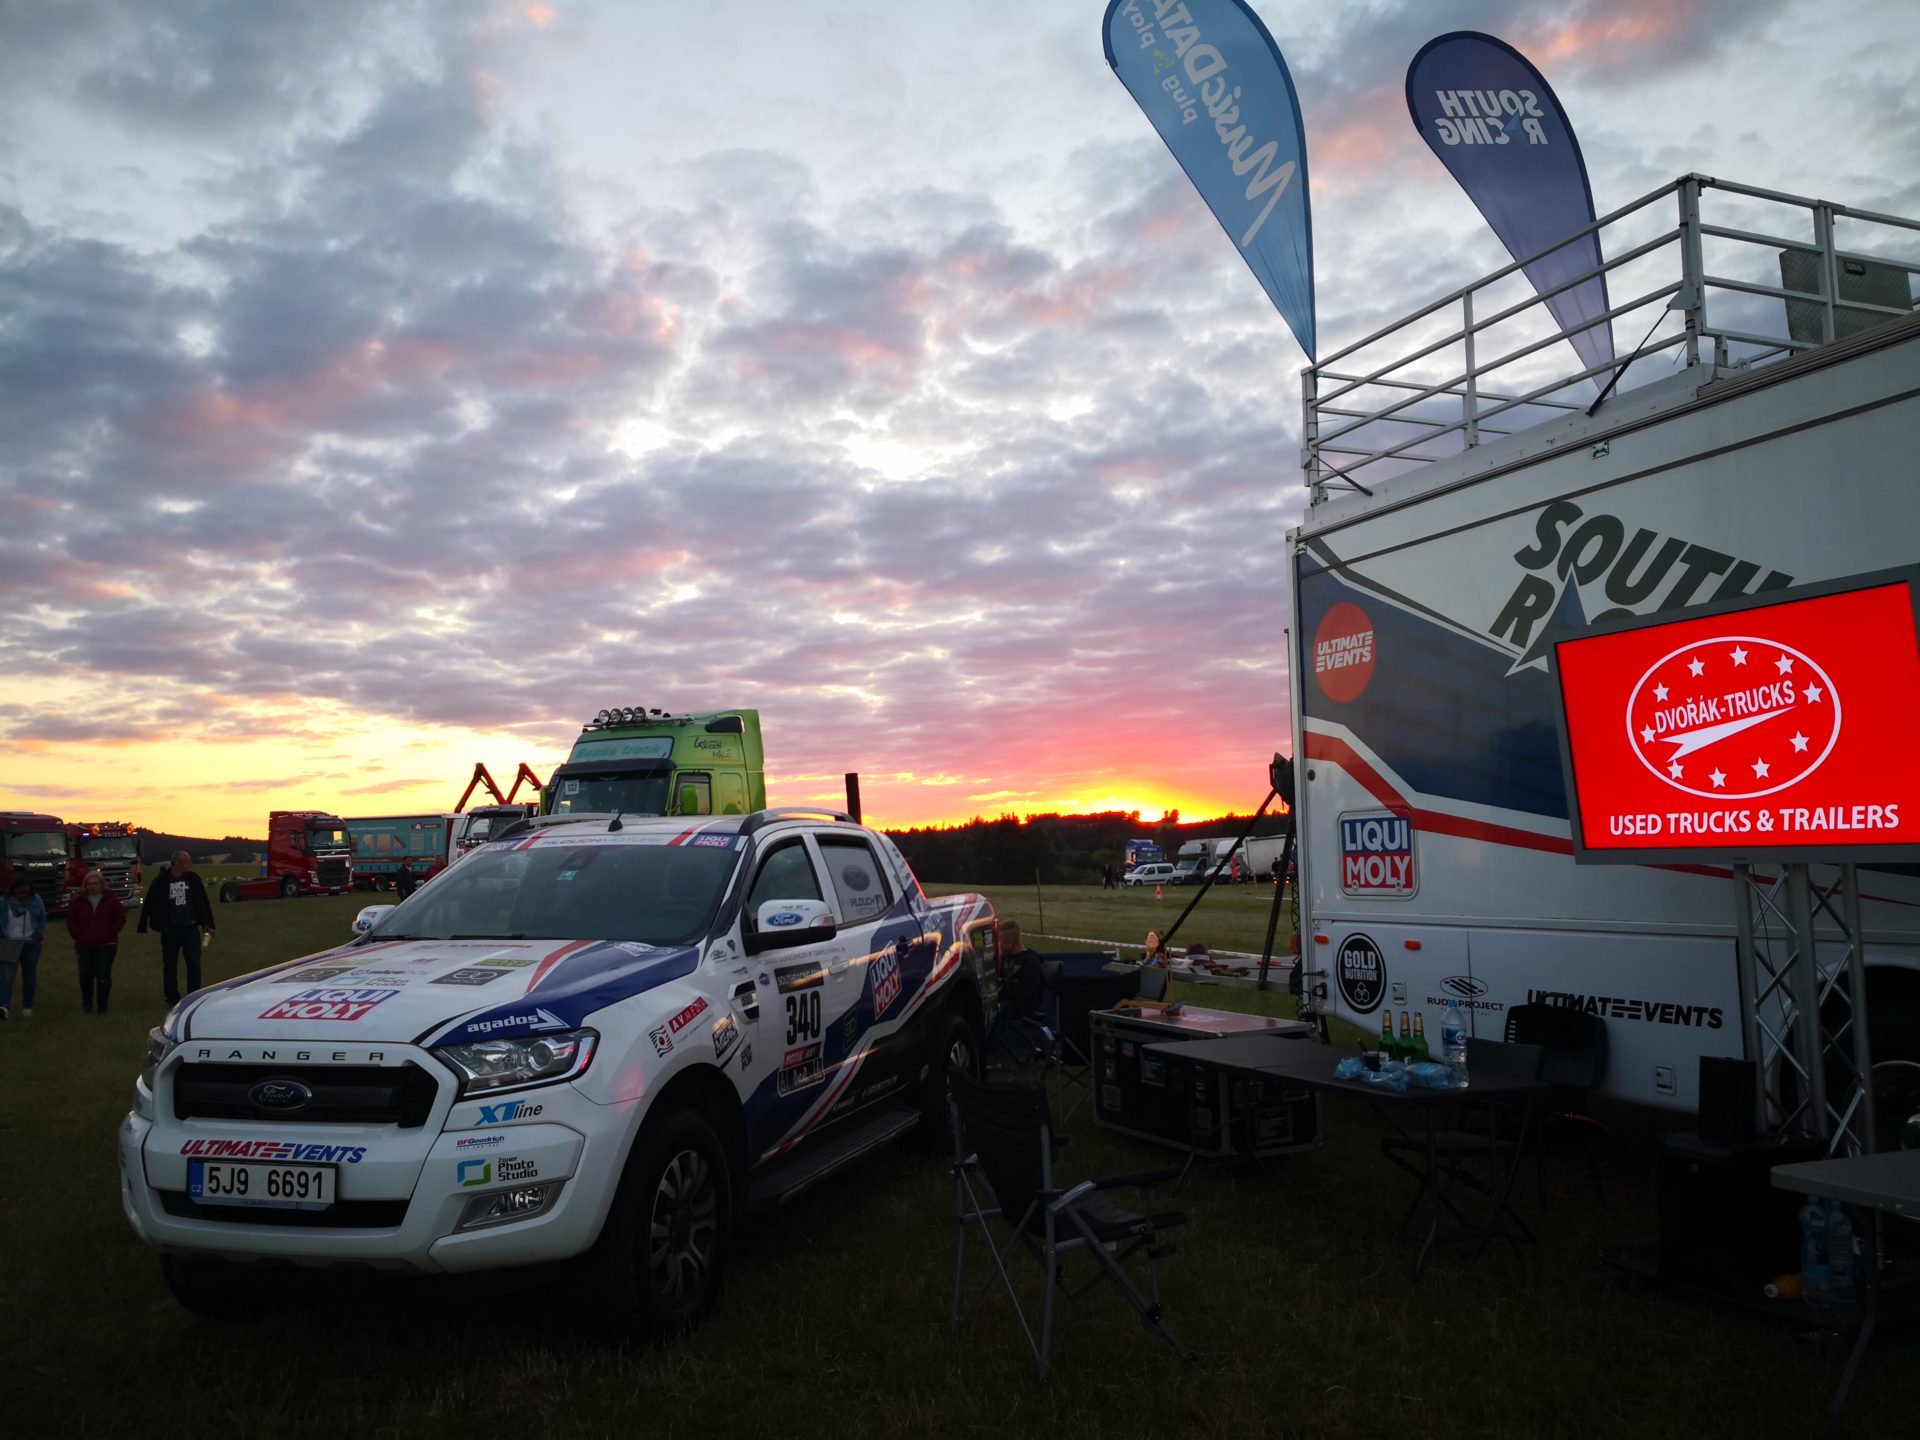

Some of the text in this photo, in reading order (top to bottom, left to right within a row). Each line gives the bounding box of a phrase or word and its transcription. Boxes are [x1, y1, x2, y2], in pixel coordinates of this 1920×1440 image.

[1317, 630, 1374, 656] ULTIMATE
[1315, 646, 1373, 674] EVENTS
[1653, 679, 1797, 735] DVOŘÁK-TRUCKS
[1609, 803, 1901, 836] USED TRUCKS & TRAILERS
[1343, 820, 1409, 853] LIQUI
[1345, 855, 1413, 888] MOLY
[1343, 949, 1377, 970] GOLD
[1344, 967, 1379, 982] NUTRITION
[293, 989, 394, 1003] LIQUI
[875, 968, 901, 1014] MOLY
[267, 1003, 378, 1019] MOLY
[1427, 997, 1457, 1007] RUD
[1458, 999, 1505, 1012] PROJECT
[466, 1014, 540, 1033] agados
[786, 990, 822, 1046] 340
[197, 1048, 385, 1061] RANGER
[258, 1085, 295, 1104] Ford
[456, 1135, 505, 1146] BFGoodrich
[497, 1160, 535, 1173] Photo
[497, 1169, 539, 1182] Studio
[191, 1184, 203, 1194] CZ
[207, 1165, 324, 1200] 5J9 6691
